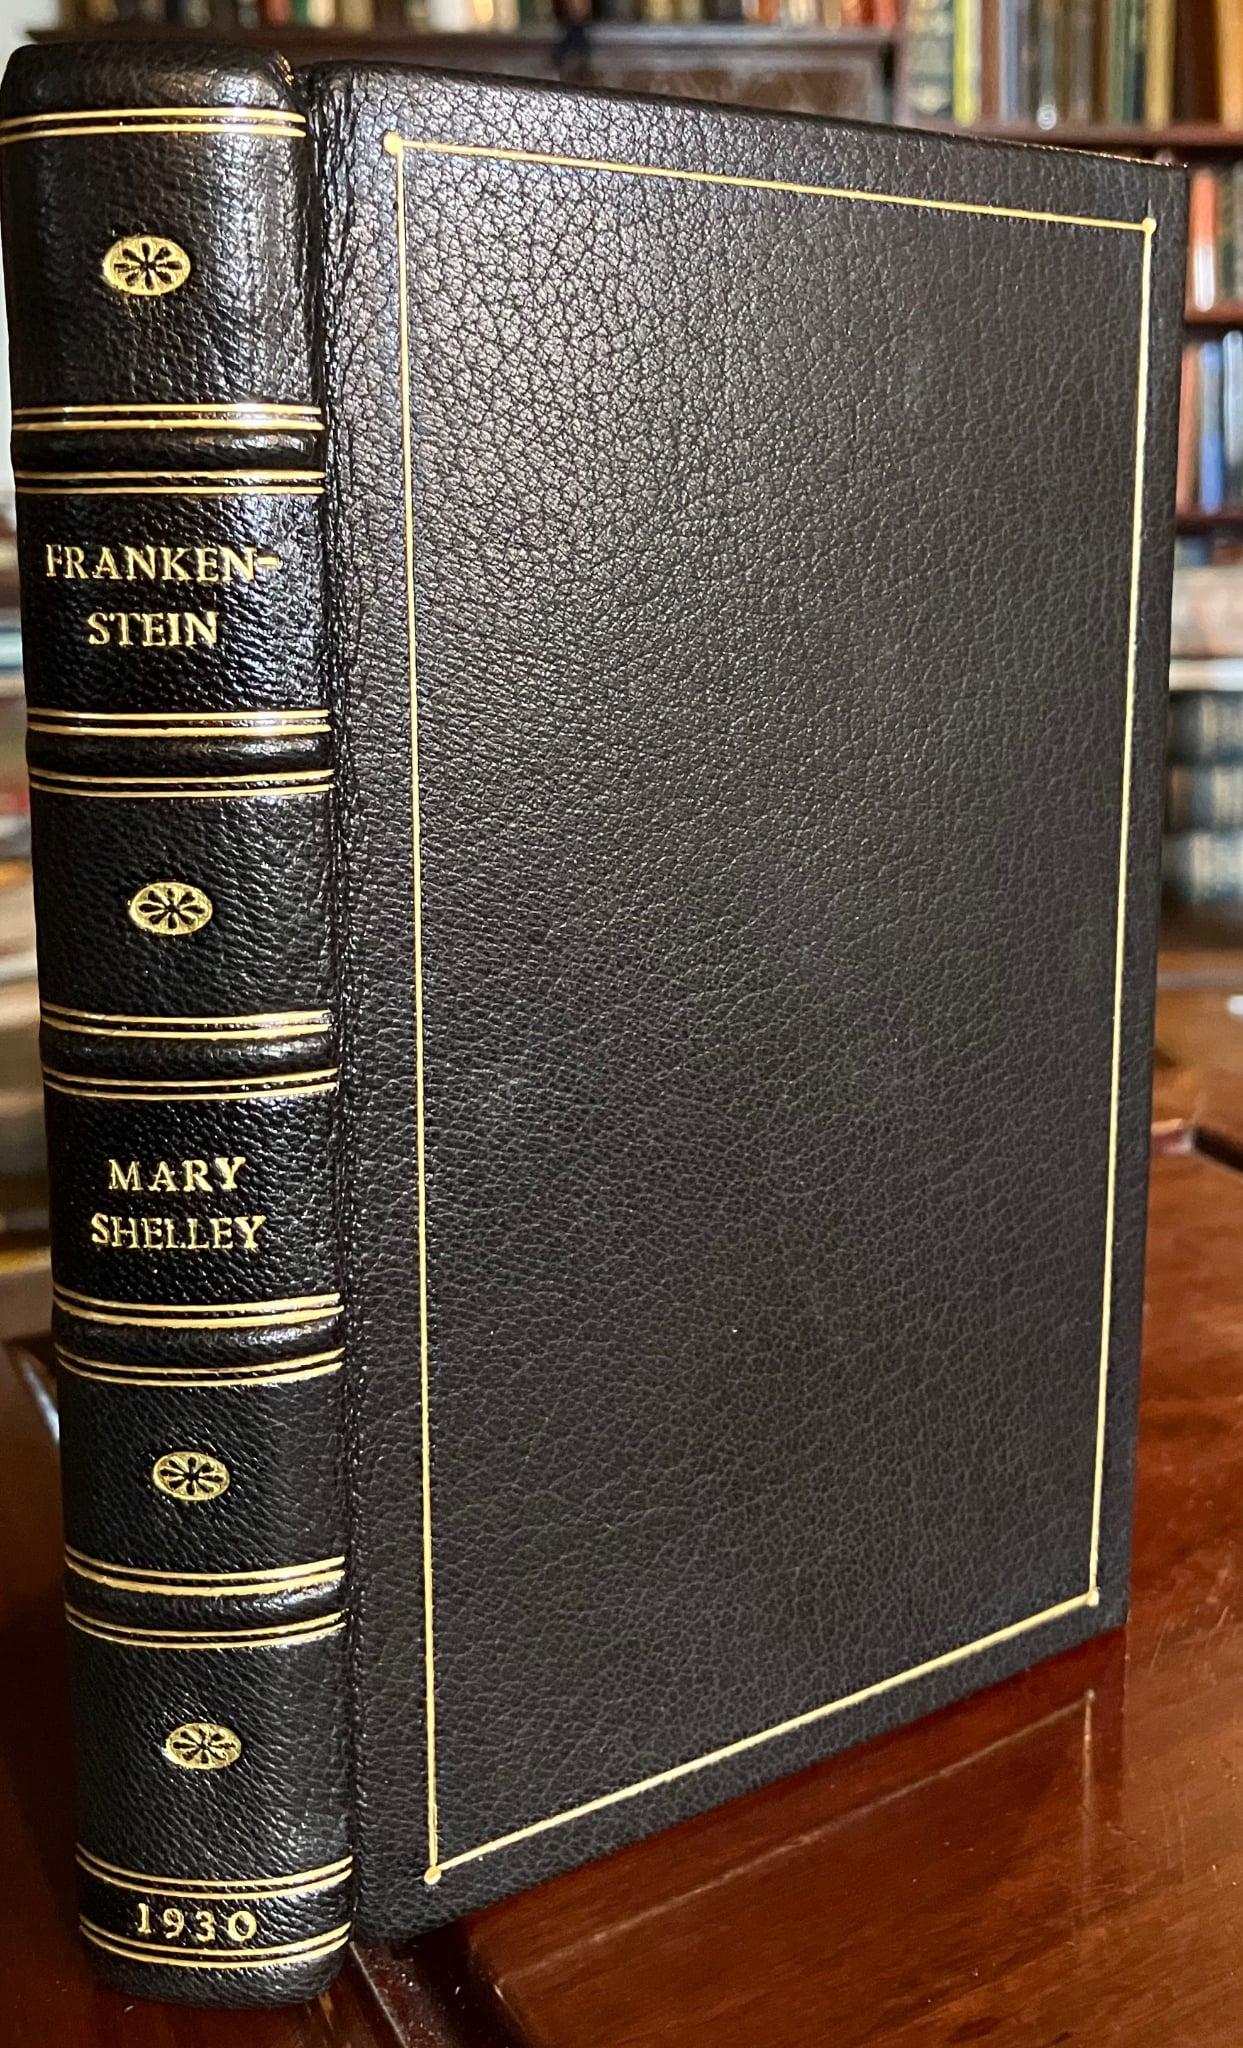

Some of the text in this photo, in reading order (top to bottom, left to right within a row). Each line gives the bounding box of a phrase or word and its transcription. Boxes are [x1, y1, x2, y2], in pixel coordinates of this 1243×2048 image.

[46, 543, 280, 582] FRANKEN-
[87, 611, 219, 648] STEIN
[108, 1156, 246, 1193] MARY
[91, 1212, 266, 1249] SHELLEY
[136, 1902, 257, 1943] 1930
